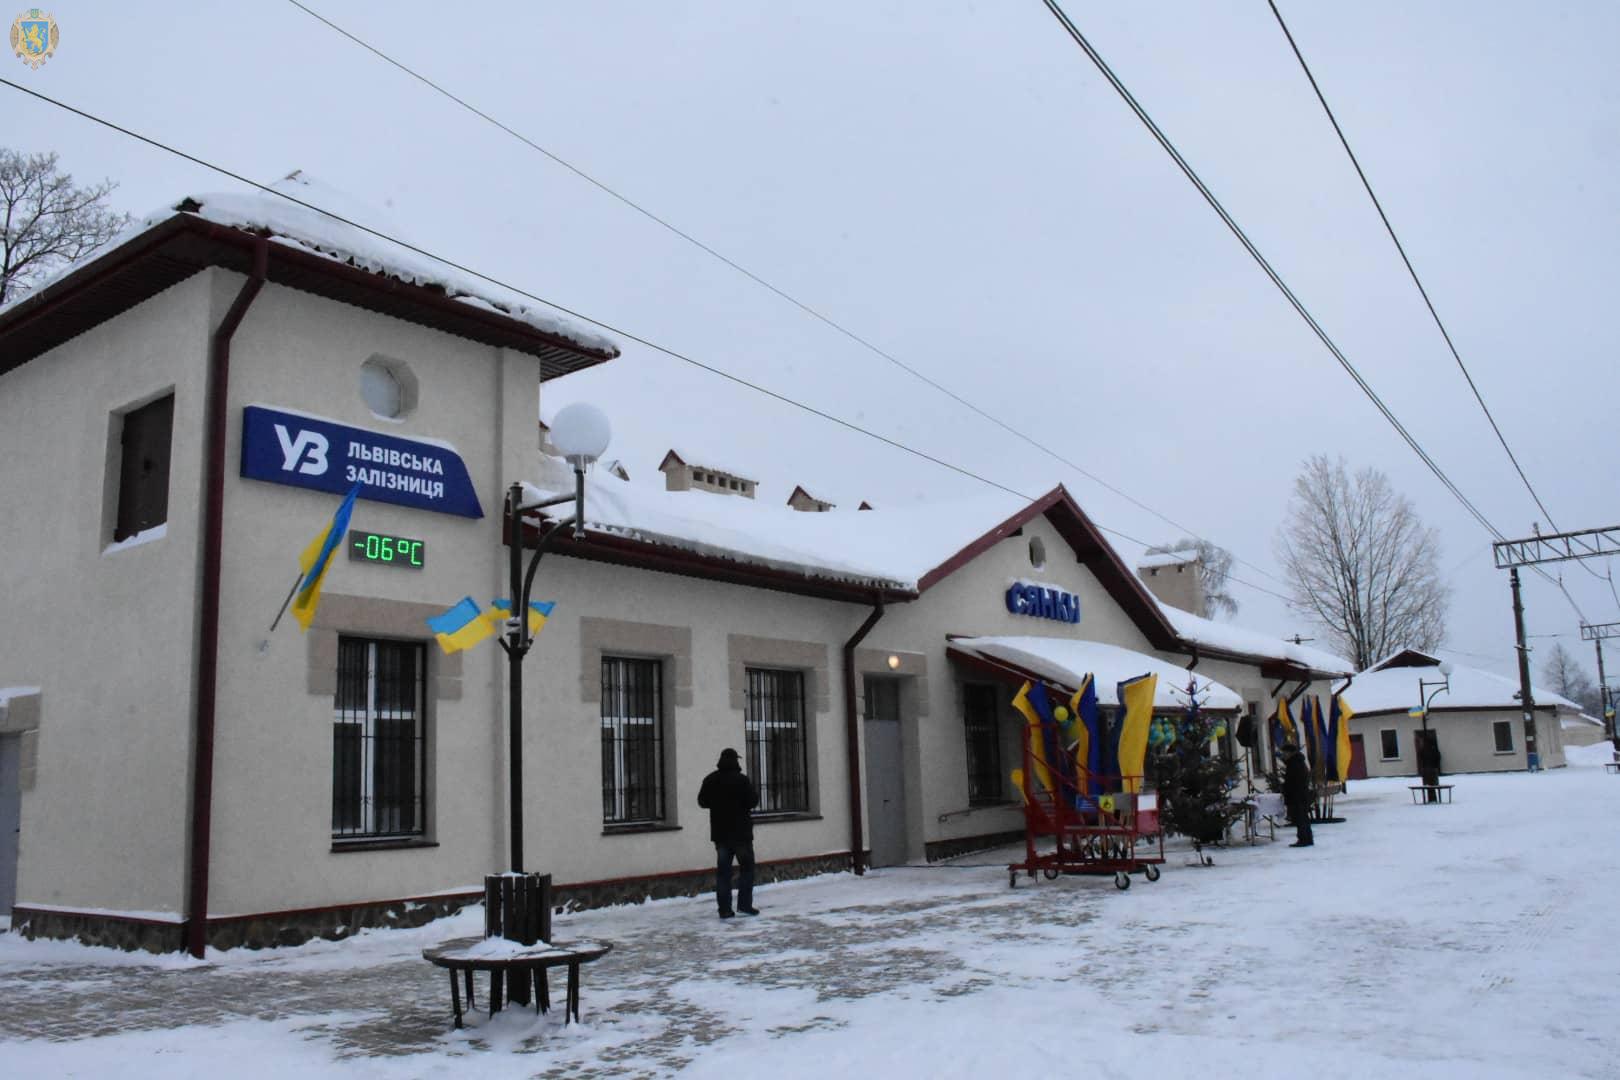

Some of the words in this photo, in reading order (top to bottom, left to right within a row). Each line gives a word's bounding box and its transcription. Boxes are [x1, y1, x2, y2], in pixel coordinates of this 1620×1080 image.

[274, 424, 329, 476] УЗ
[347, 441, 443, 475] ЛЬВІВСЬКА
[346, 465, 444, 499] ЗАЛІЗНИЦЯ
[1006, 582, 1080, 624] СЯНКИ
